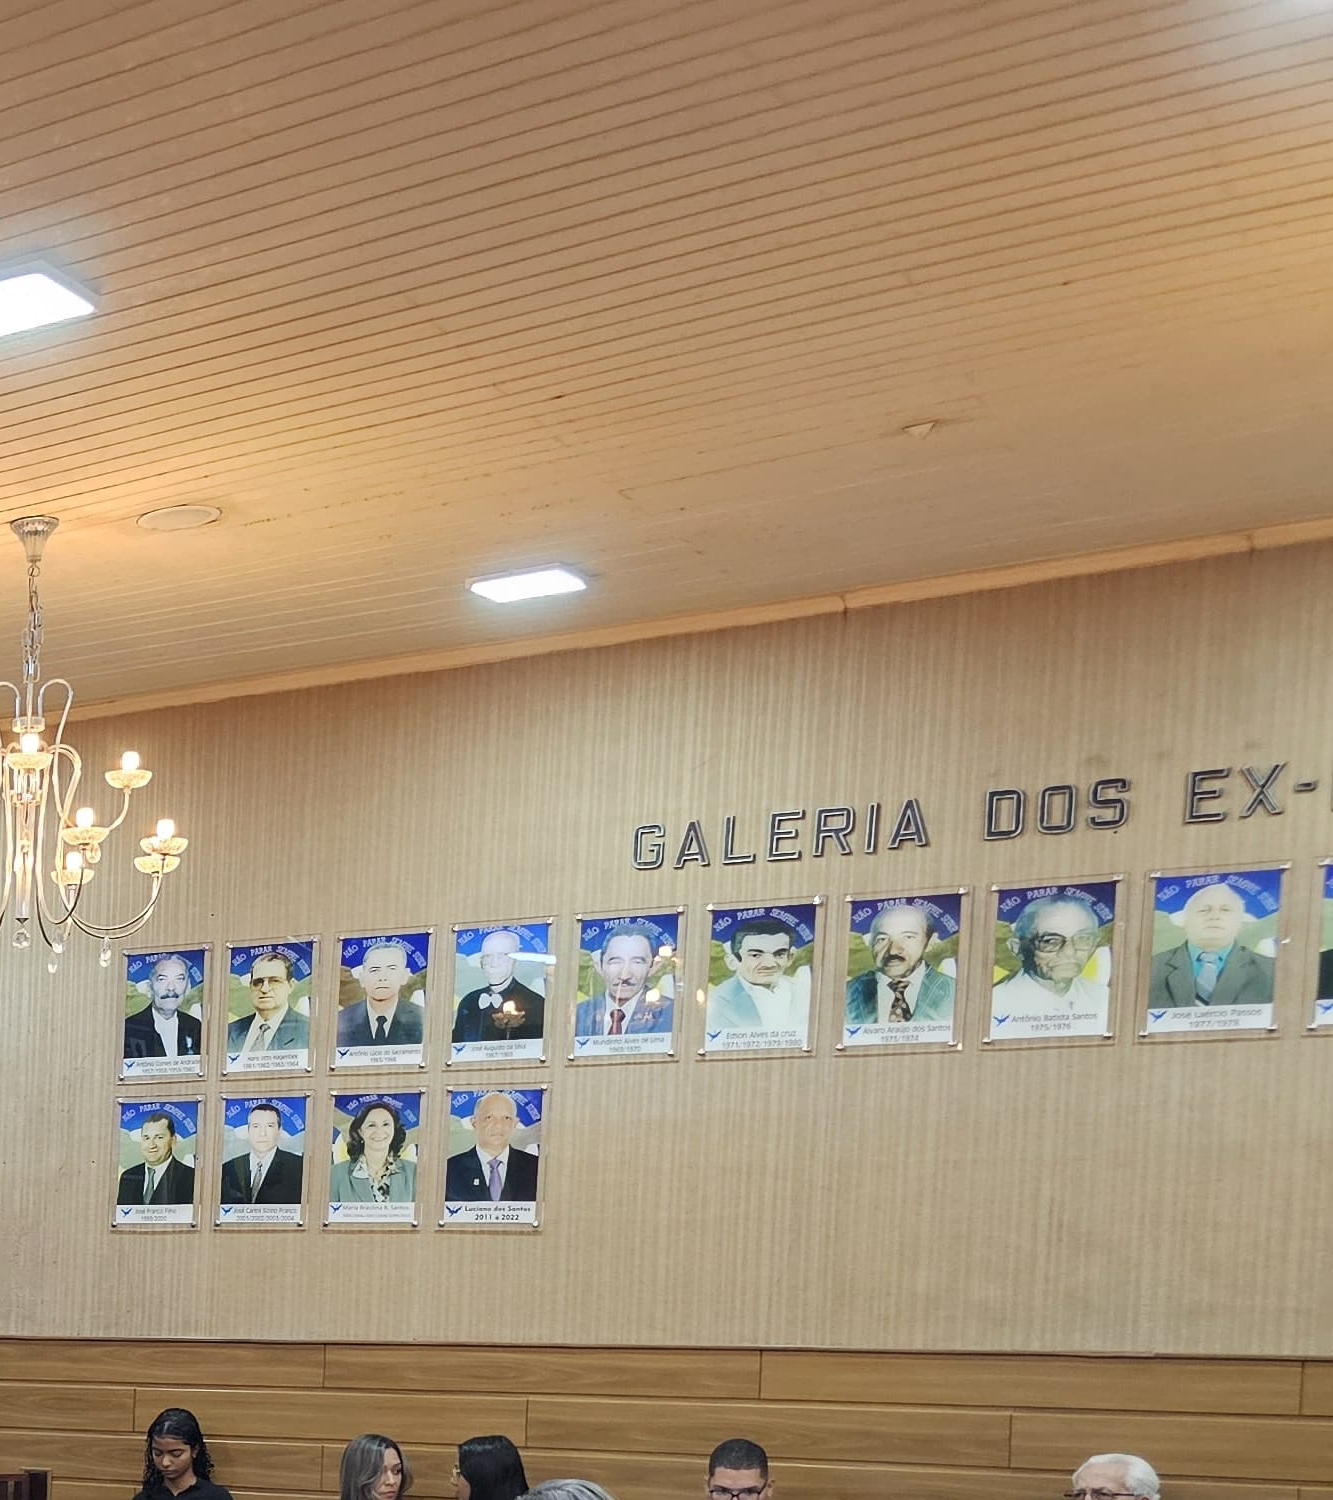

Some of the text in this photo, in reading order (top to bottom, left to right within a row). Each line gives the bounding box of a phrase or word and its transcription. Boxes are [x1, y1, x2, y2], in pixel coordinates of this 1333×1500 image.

[631, 762, 1333, 871] GALERIA DOS EX-
[853, 907, 873, 923] NÃO
[877, 898, 907, 911] PARAR
[1000, 896, 1021, 912] NÃO
[1027, 887, 1058, 900] PARAR
[713, 916, 732, 931] NÃO
[737, 908, 765, 920] PARAR
